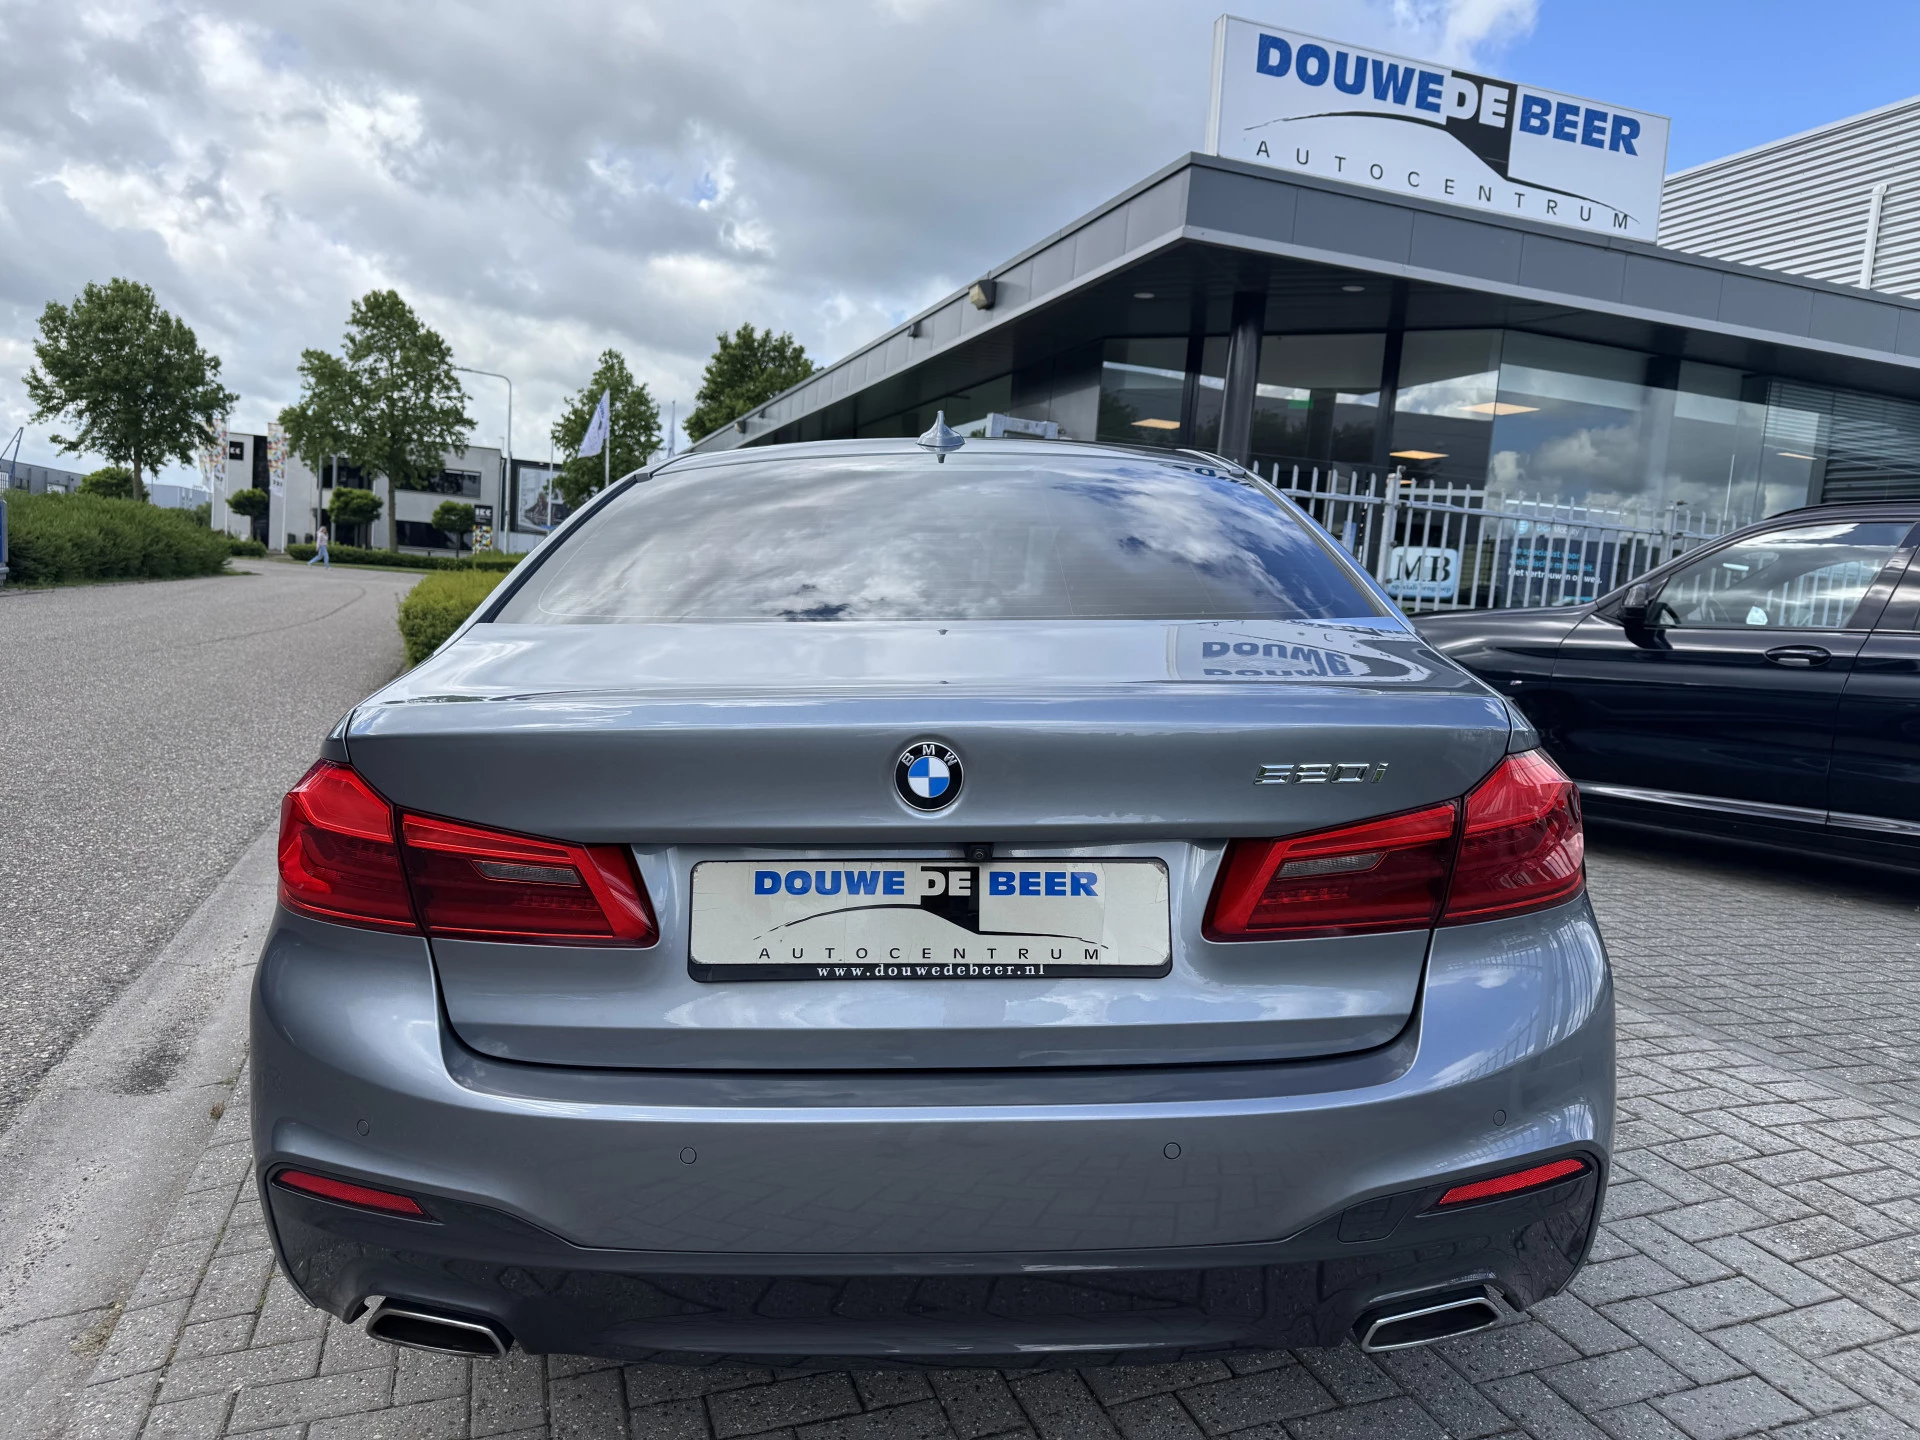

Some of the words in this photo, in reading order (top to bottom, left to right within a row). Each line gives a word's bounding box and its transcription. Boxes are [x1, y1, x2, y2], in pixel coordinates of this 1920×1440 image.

[1256, 33, 1445, 114] DOUWE
[1447, 75, 1509, 129] DE
[1519, 94, 1641, 156] BEER
[1256, 140, 1629, 230] AUTOCENTRUM
[1395, 555, 1451, 582] MB
[901, 744, 958, 767] BMW
[1254, 762, 1389, 785] 520i
[753, 870, 905, 895] DOUWE
[921, 870, 972, 896] DE
[988, 871, 1099, 897] BEER
[758, 947, 1099, 960] AUTOCENTRUM
[817, 963, 1045, 977] www.douwedebeer.nl
